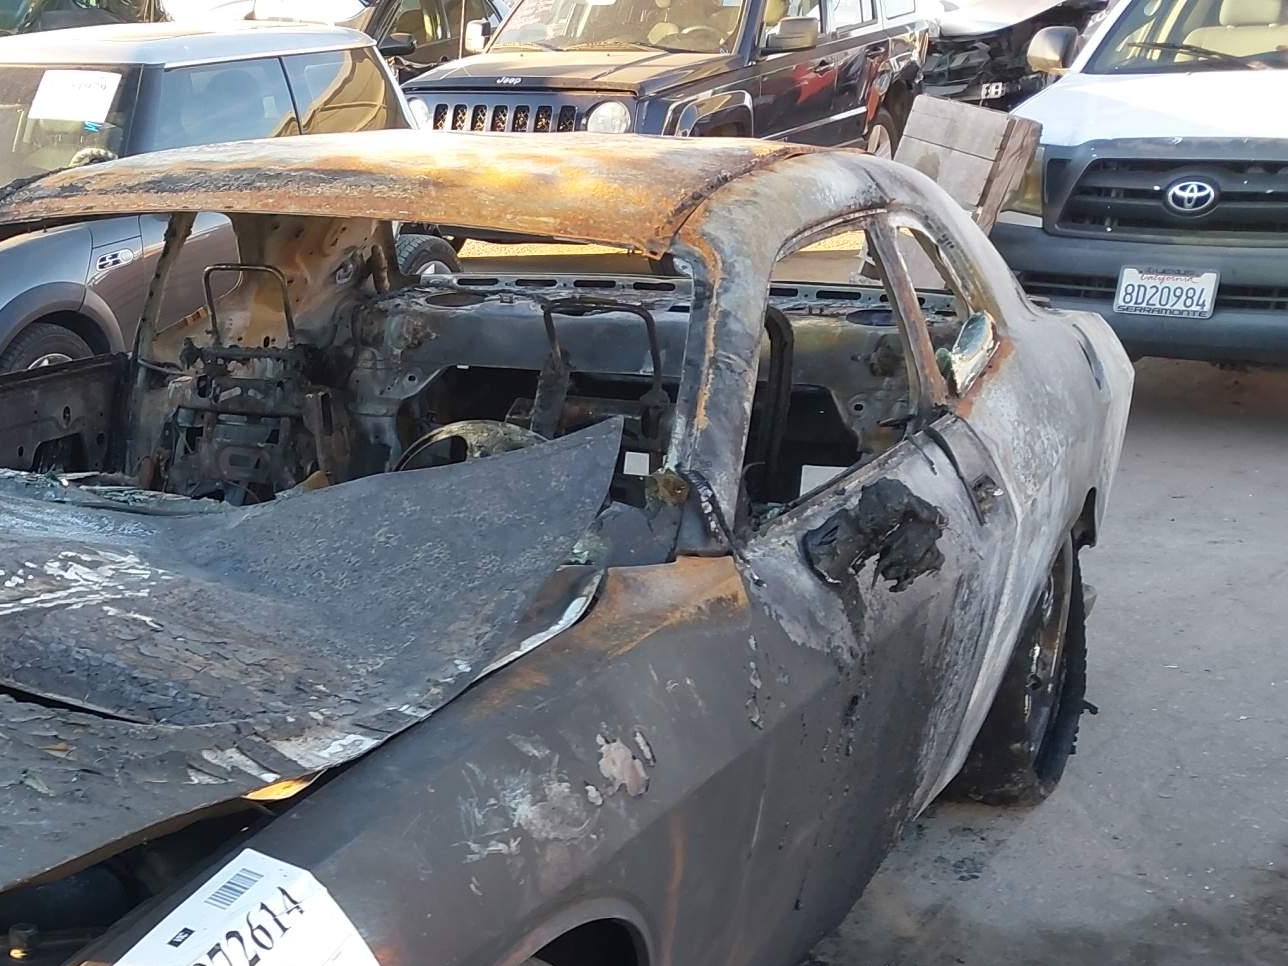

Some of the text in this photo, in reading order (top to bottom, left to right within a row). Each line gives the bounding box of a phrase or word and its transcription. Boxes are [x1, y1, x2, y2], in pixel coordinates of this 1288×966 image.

[496, 76, 522, 86] Jeep
[1140, 273, 1200, 285] California
[1122, 283, 1207, 310] 8D20984
[1117, 305, 1209, 318] SERRAMONTE
